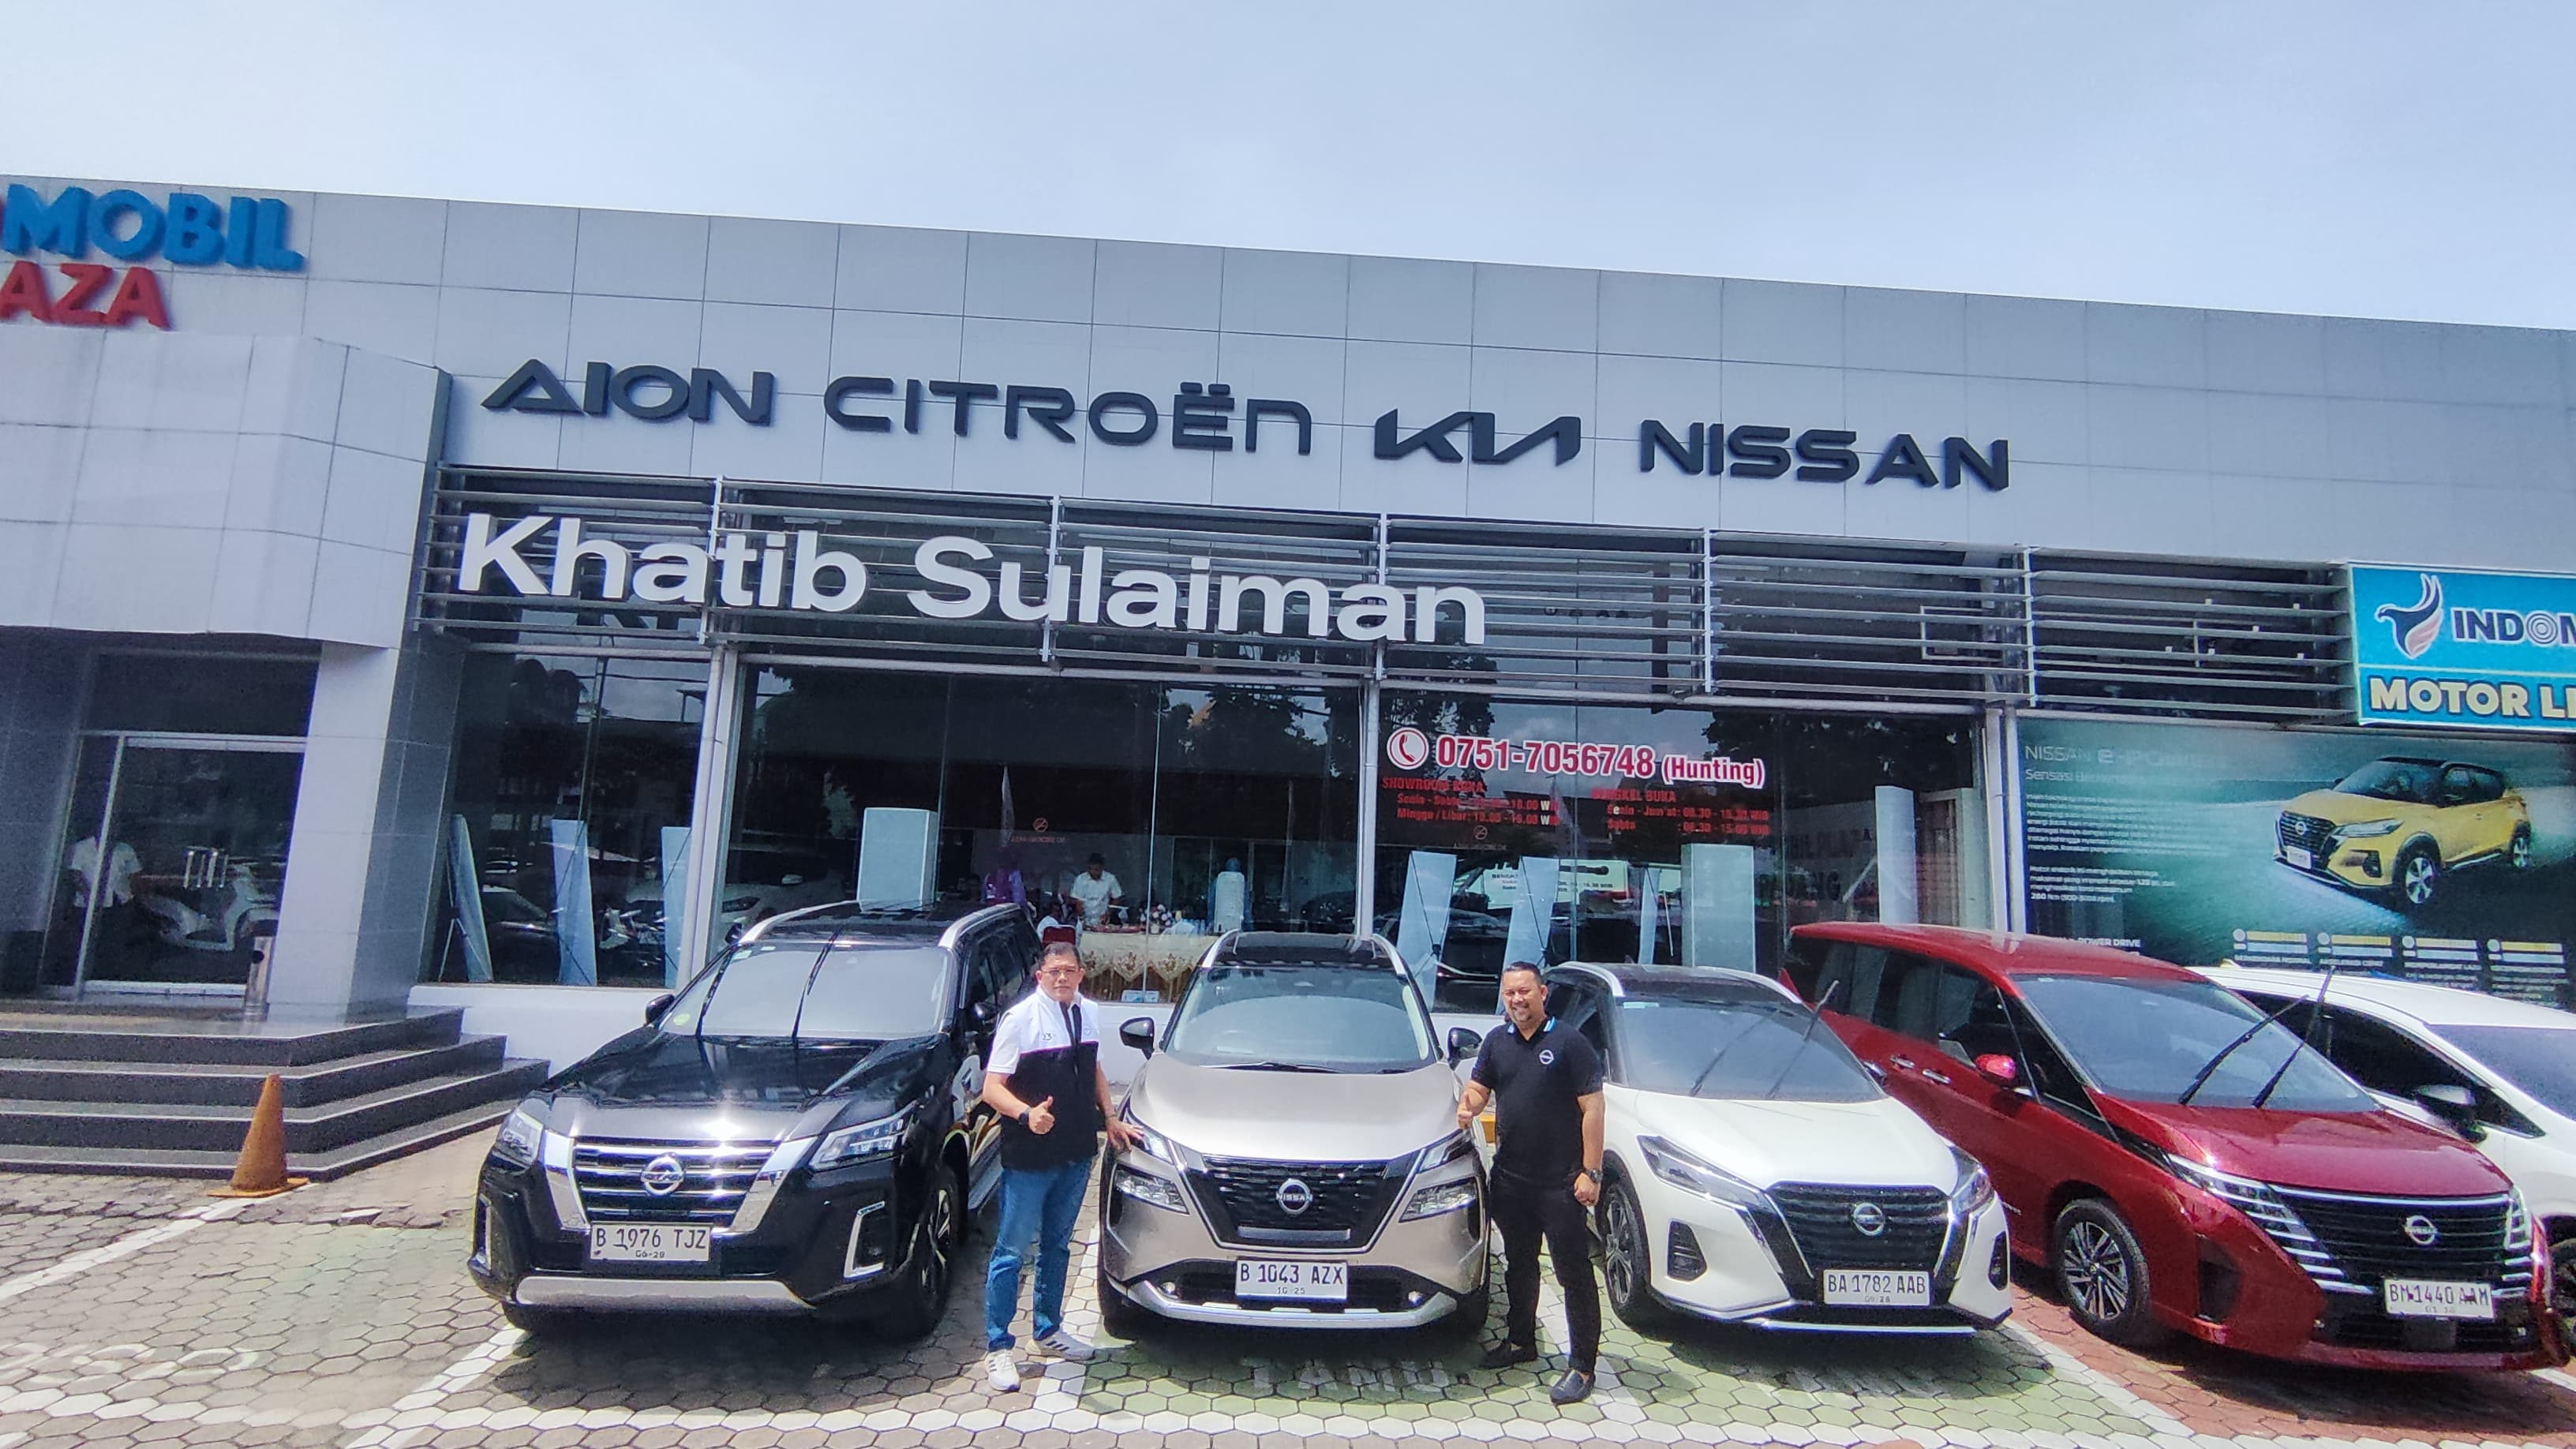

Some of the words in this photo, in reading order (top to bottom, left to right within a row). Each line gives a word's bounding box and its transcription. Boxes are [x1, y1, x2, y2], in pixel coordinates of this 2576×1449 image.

[0, 183, 309, 272] MOBIL
[480, 358, 775, 426] AION
[1639, 419, 2010, 491] NISSAN
[458, 512, 867, 612] Khatib
[907, 535, 1485, 646] Sulaiman
[2369, 677, 2531, 717] MOTOR
[1436, 734, 1656, 778] 0751-7056748
[1661, 754, 1766, 788] (Hunting)
[2025, 745, 2090, 762] NISSAN
[2025, 769, 2072, 781] Sensasi
[1276, 1190, 1314, 1202] NISSAN
[596, 1228, 606, 1247] B
[612, 1228, 661, 1251] 1976
[673, 1230, 707, 1249] TJZ
[1240, 1264, 1250, 1282] B
[1257, 1264, 1299, 1283] 1043
[1311, 1266, 1343, 1285] AZX
[1828, 1275, 1848, 1293] BA
[1852, 1275, 1891, 1294] 1782
[1896, 1275, 1926, 1294] AAB
[2413, 1284, 2454, 1305] 1440
